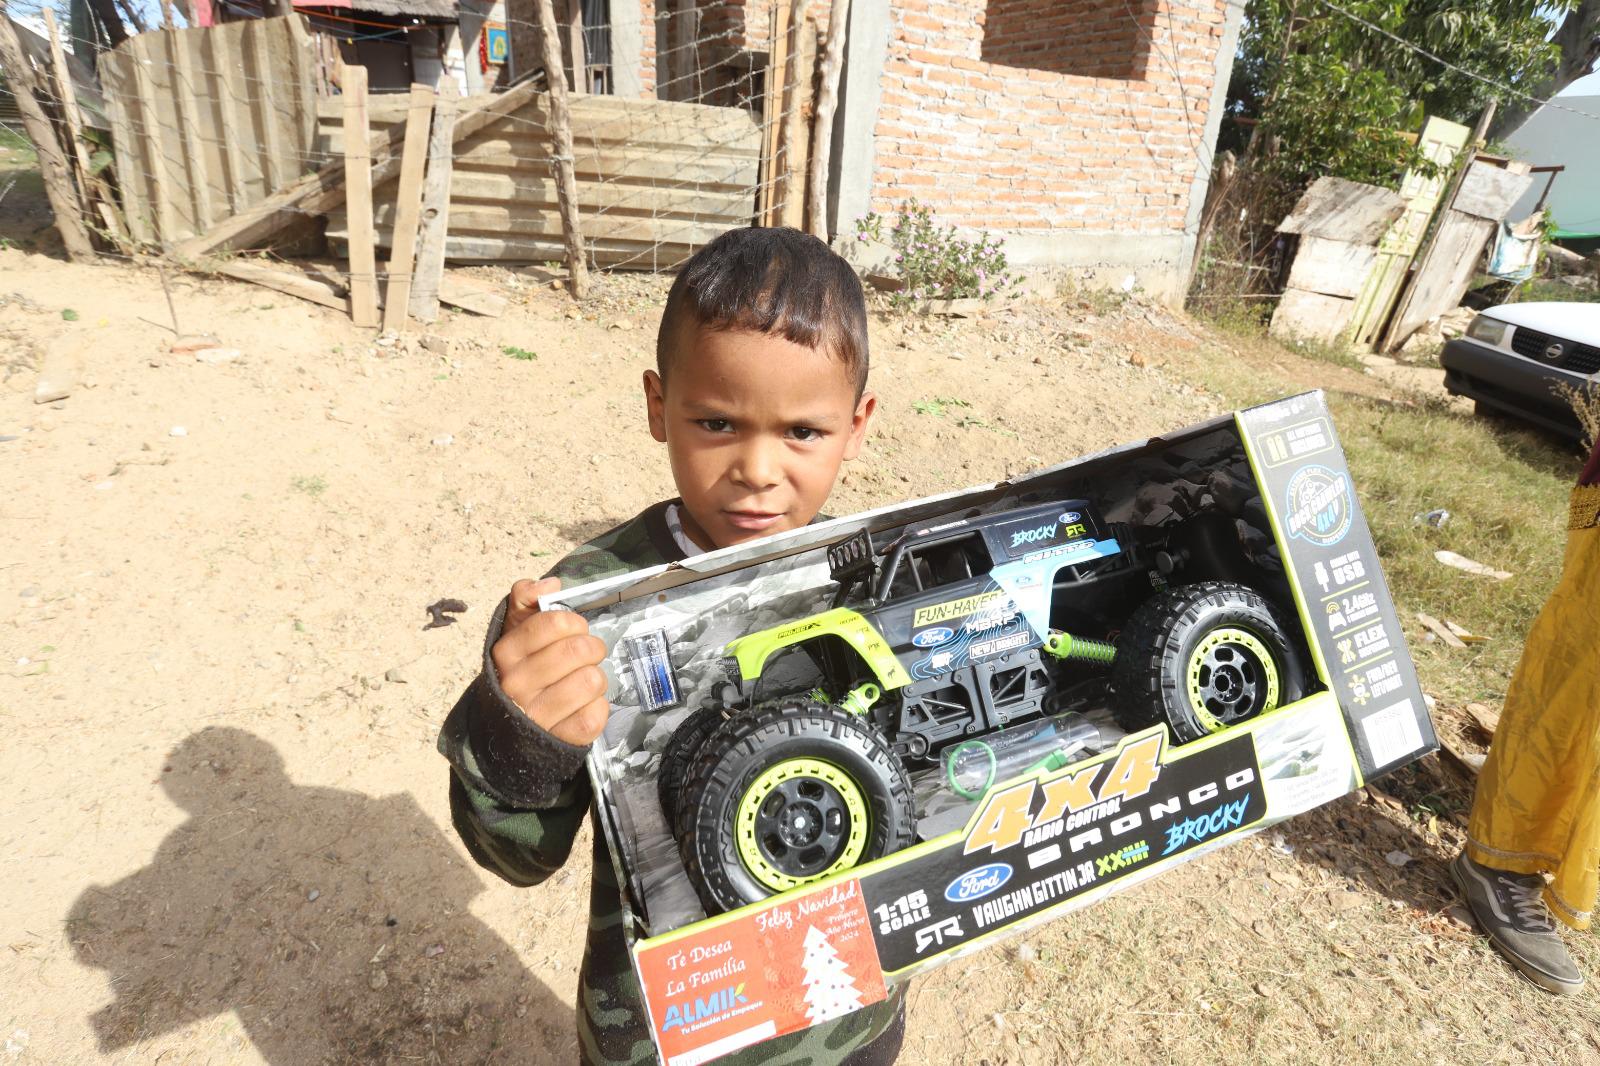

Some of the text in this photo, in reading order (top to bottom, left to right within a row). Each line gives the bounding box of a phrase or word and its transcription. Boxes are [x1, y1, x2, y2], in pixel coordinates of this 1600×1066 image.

[1288, 504, 1311, 534] ROCK
[1009, 523, 1057, 549] BROCKY
[1332, 560, 1366, 585] USB
[916, 593, 999, 624] FUN-HAVE
[1353, 624, 1388, 649] FLEX
[1023, 797, 1121, 848] RADIO CONTROL
[1027, 767, 1255, 870] BRONCO
[1161, 793, 1250, 856] BROCKY
[755, 880, 858, 932] Feliz Navidad
[874, 889, 928, 922] 1:15
[972, 890, 1035, 928] VAUGHN
[1031, 872, 1078, 905] GITTIN
[879, 906, 931, 935] SCALE
[667, 940, 732, 970] Te Desea
[665, 978, 686, 997] La
[662, 982, 748, 1032] ALMIK
[681, 1027, 690, 1035] Tu
[721, 1012, 731, 1021] de
